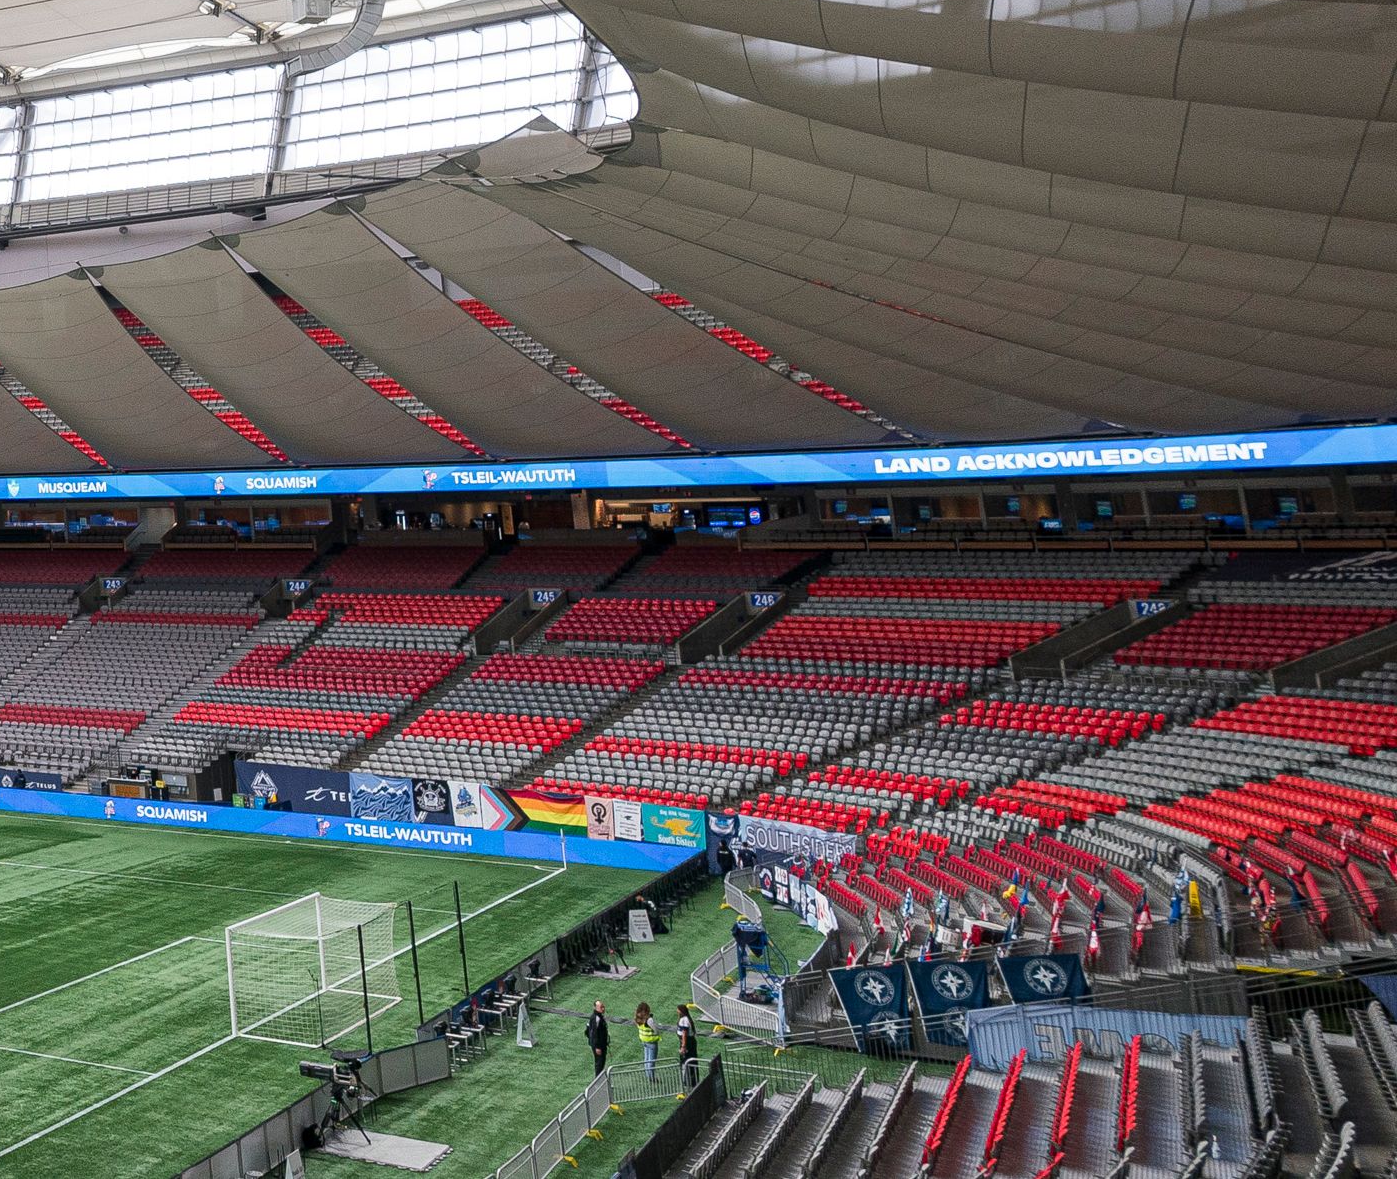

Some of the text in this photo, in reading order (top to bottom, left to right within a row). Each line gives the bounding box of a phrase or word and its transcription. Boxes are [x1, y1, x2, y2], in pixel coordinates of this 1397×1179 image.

[874, 442, 1268, 474] LAND ACKNOWLEDGEMENT
[246, 476, 317, 490] SQUAMISH
[451, 469, 576, 485] TSLEIL-WAUTUTH
[38, 481, 107, 494] MUSQUEAM
[105, 579, 121, 589] 243
[289, 581, 305, 590] 244
[536, 591, 554, 603] 245
[754, 594, 774, 605] 246
[136, 804, 207, 823] SQUAMISH
[345, 823, 473, 846] TSLEIL-WAUTUTH
[657, 834, 697, 848] South Sisters
